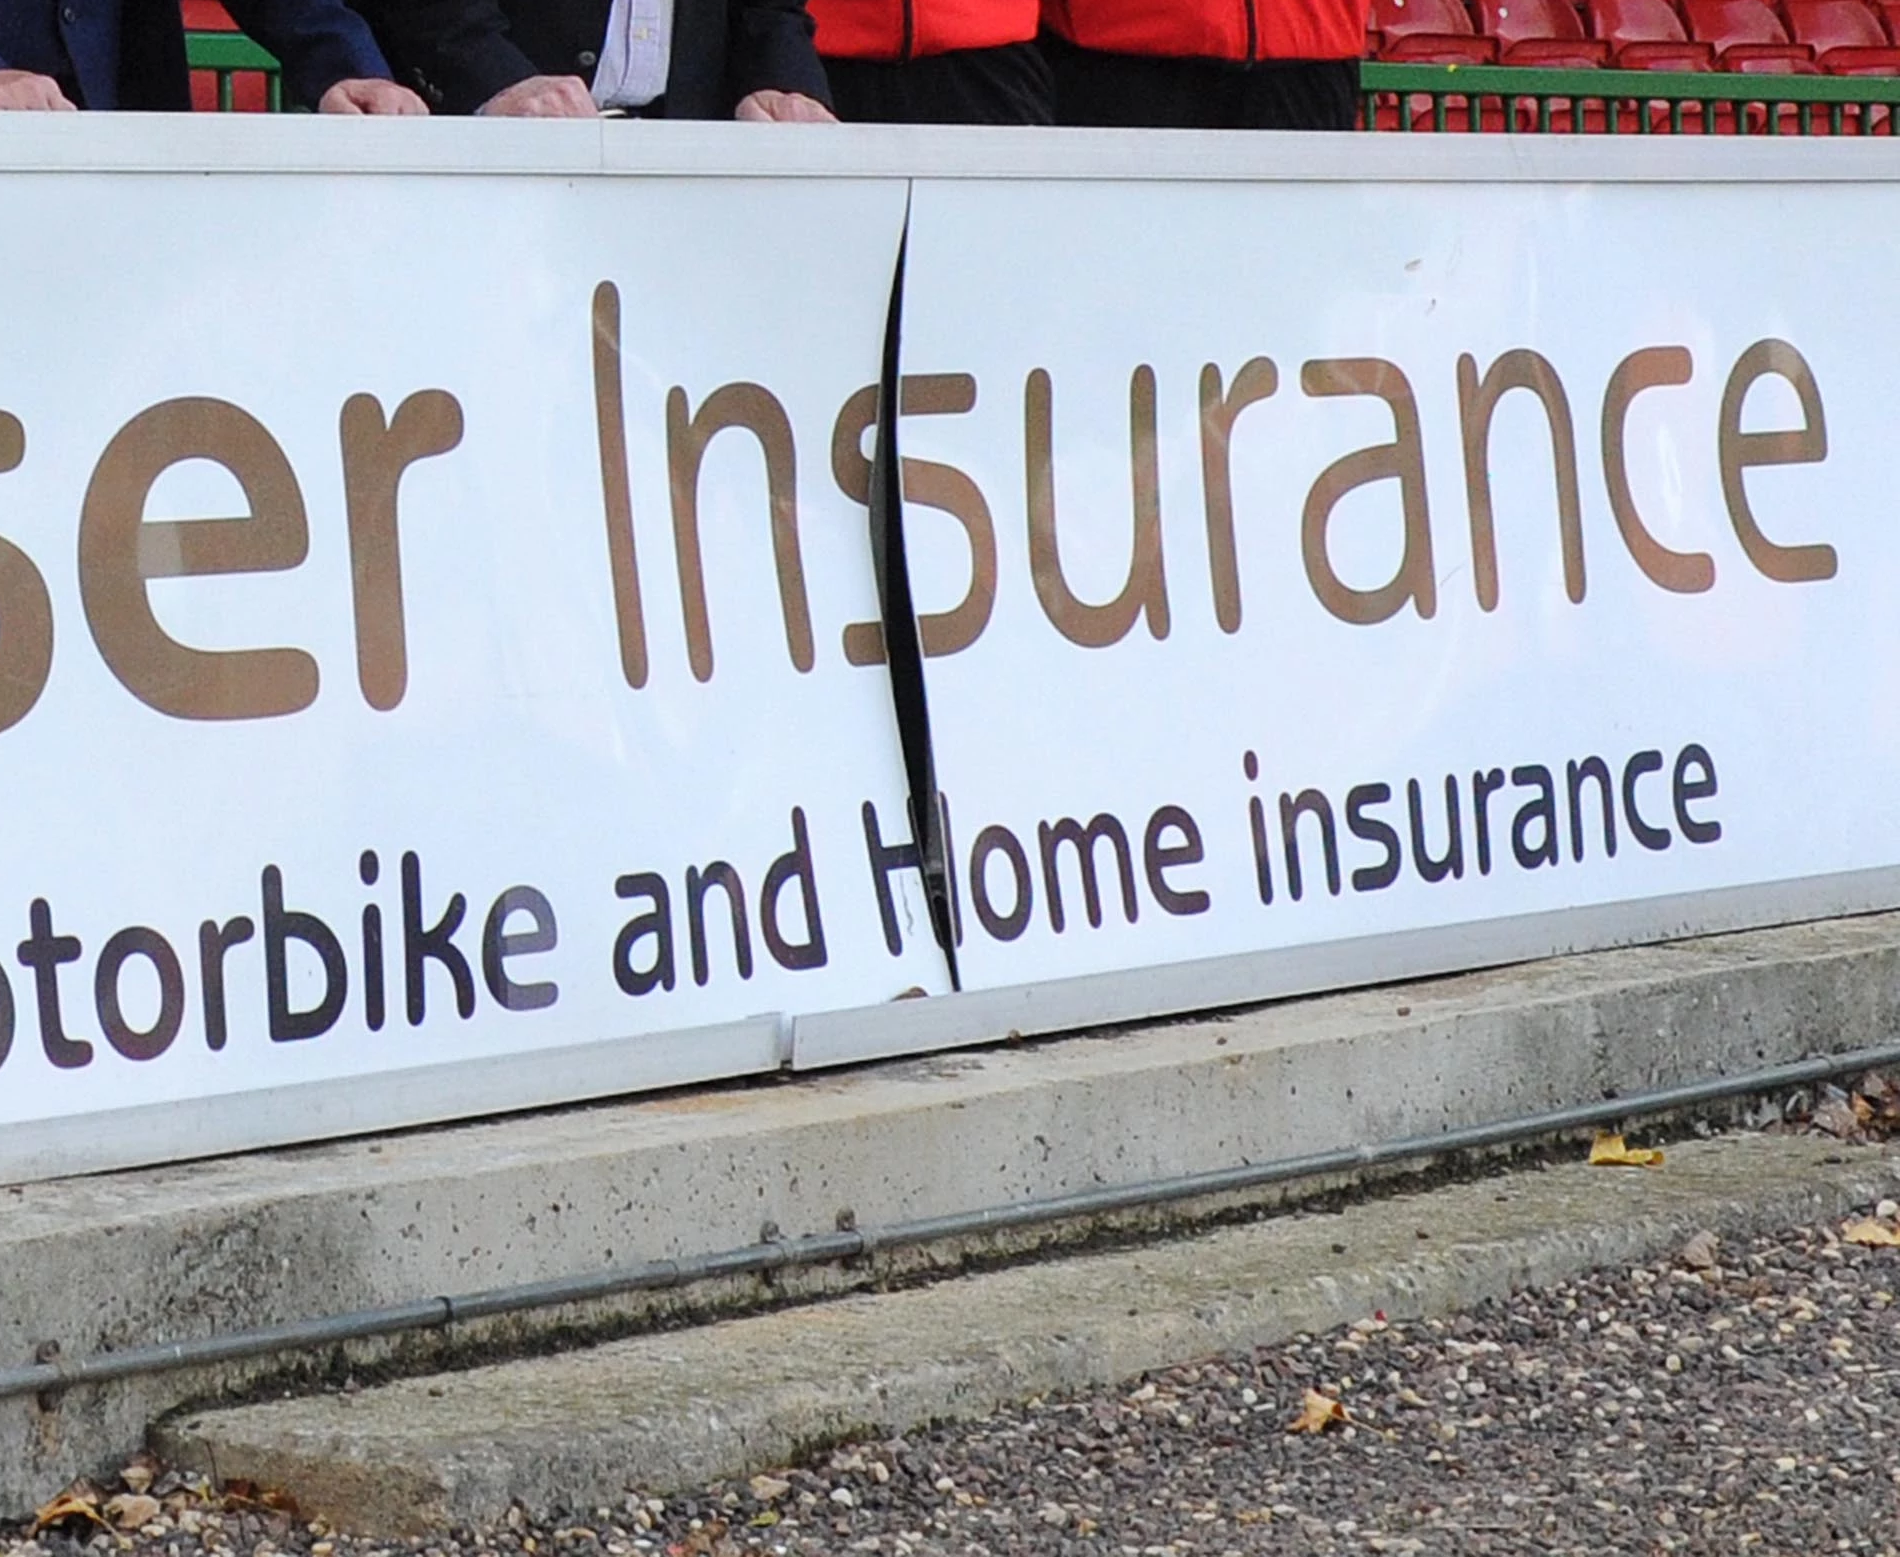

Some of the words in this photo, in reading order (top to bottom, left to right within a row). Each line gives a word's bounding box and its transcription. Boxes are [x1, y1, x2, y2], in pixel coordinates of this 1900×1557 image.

[592, 280, 1837, 690] Insurance
[613, 805, 828, 998] and
[862, 789, 1211, 957] Home
[1242, 742, 1723, 906] insurance
